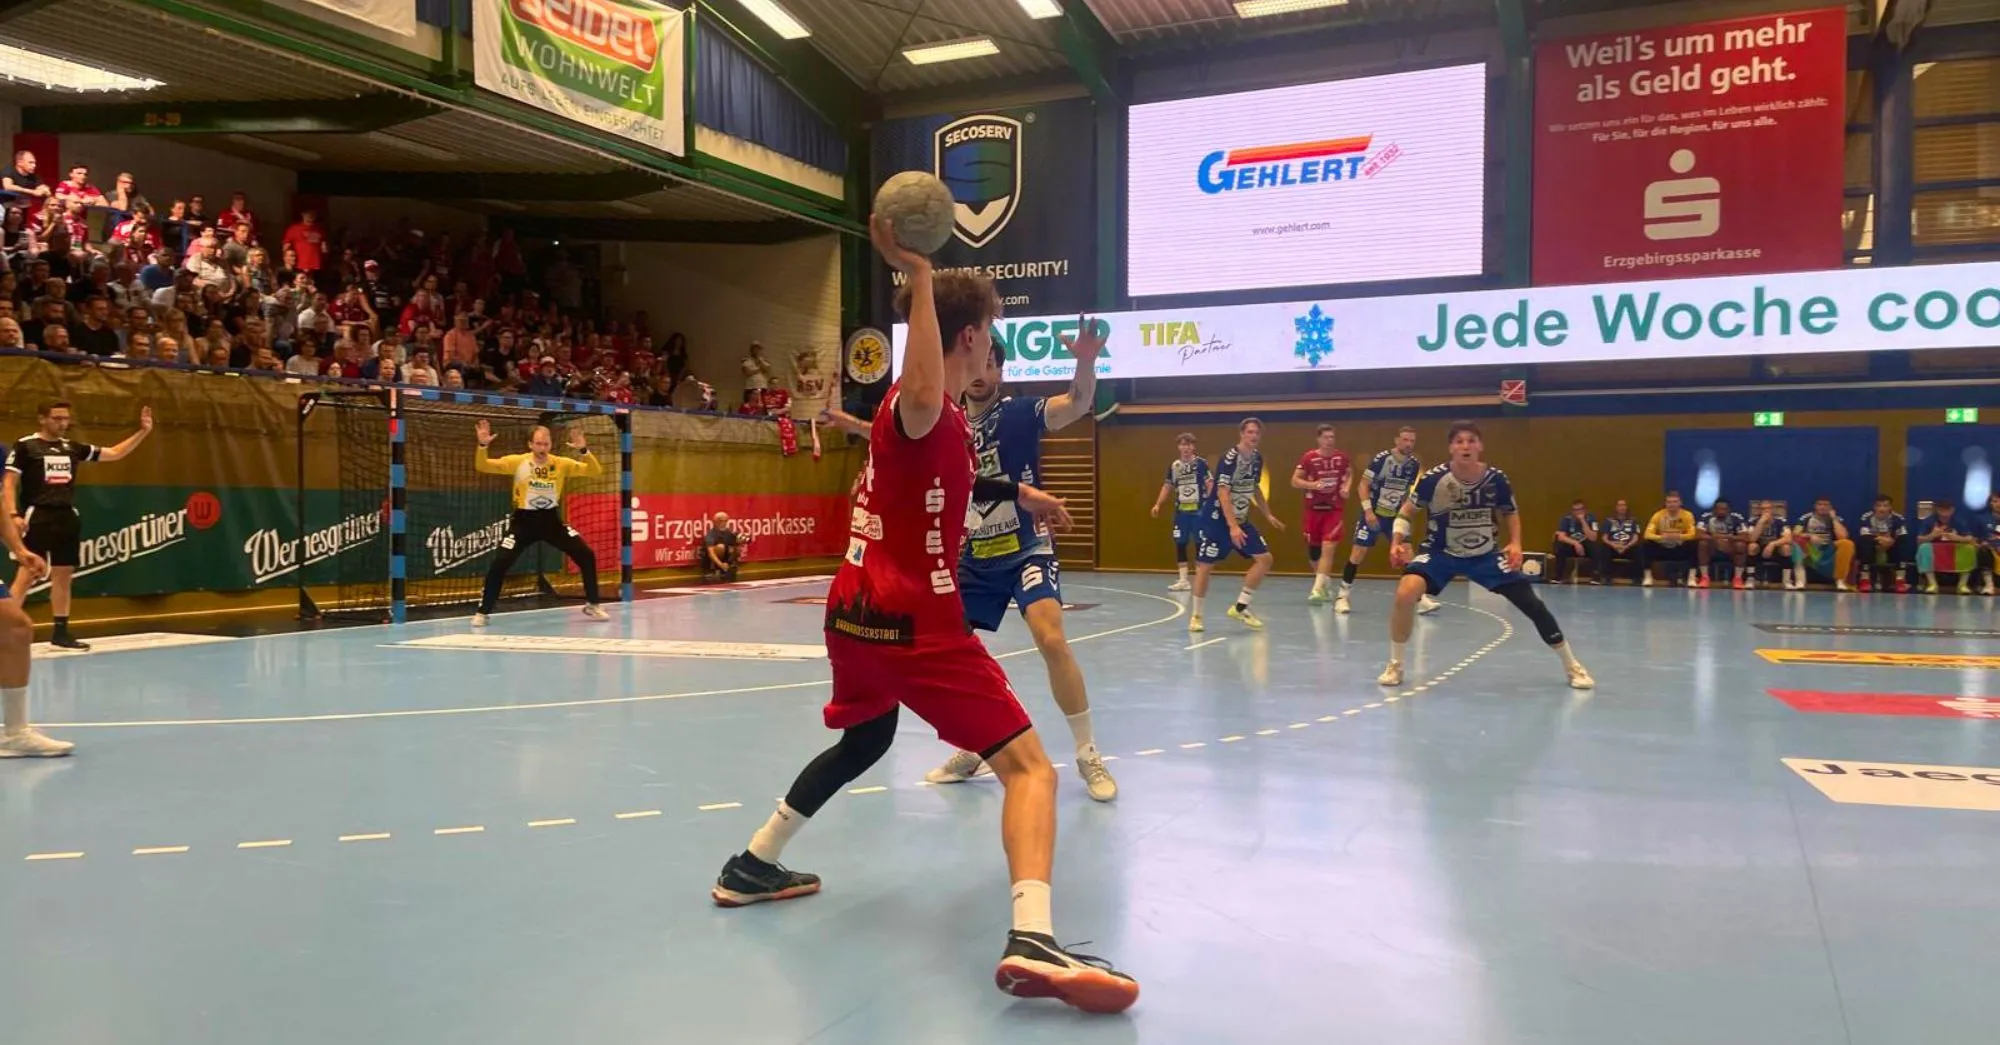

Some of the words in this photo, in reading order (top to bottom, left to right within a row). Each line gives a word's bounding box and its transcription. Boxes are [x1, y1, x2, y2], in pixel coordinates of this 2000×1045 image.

[1565, 35, 1655, 68] Weil's
[1664, 33, 1714, 58] um
[1724, 18, 1812, 51] mehr
[514, 33, 657, 106] WOHNWELT
[1577, 75, 1621, 102] als
[1630, 63, 1701, 96] Geld
[1710, 56, 1797, 95] geht.
[944, 125, 1013, 147] SECOSERV
[1198, 151, 1366, 194] GEHLERT
[1251, 222, 1331, 236] www.gehlert.com
[985, 259, 1069, 281] SECURITY!
[1603, 248, 1762, 269] Erzgebirgssparkasse
[1417, 300, 1569, 352] Jede
[1592, 287, 1840, 344] Woche
[1868, 288, 2000, 333] coo
[1139, 321, 1200, 347] TIFA
[655, 547, 674, 562] Wir
